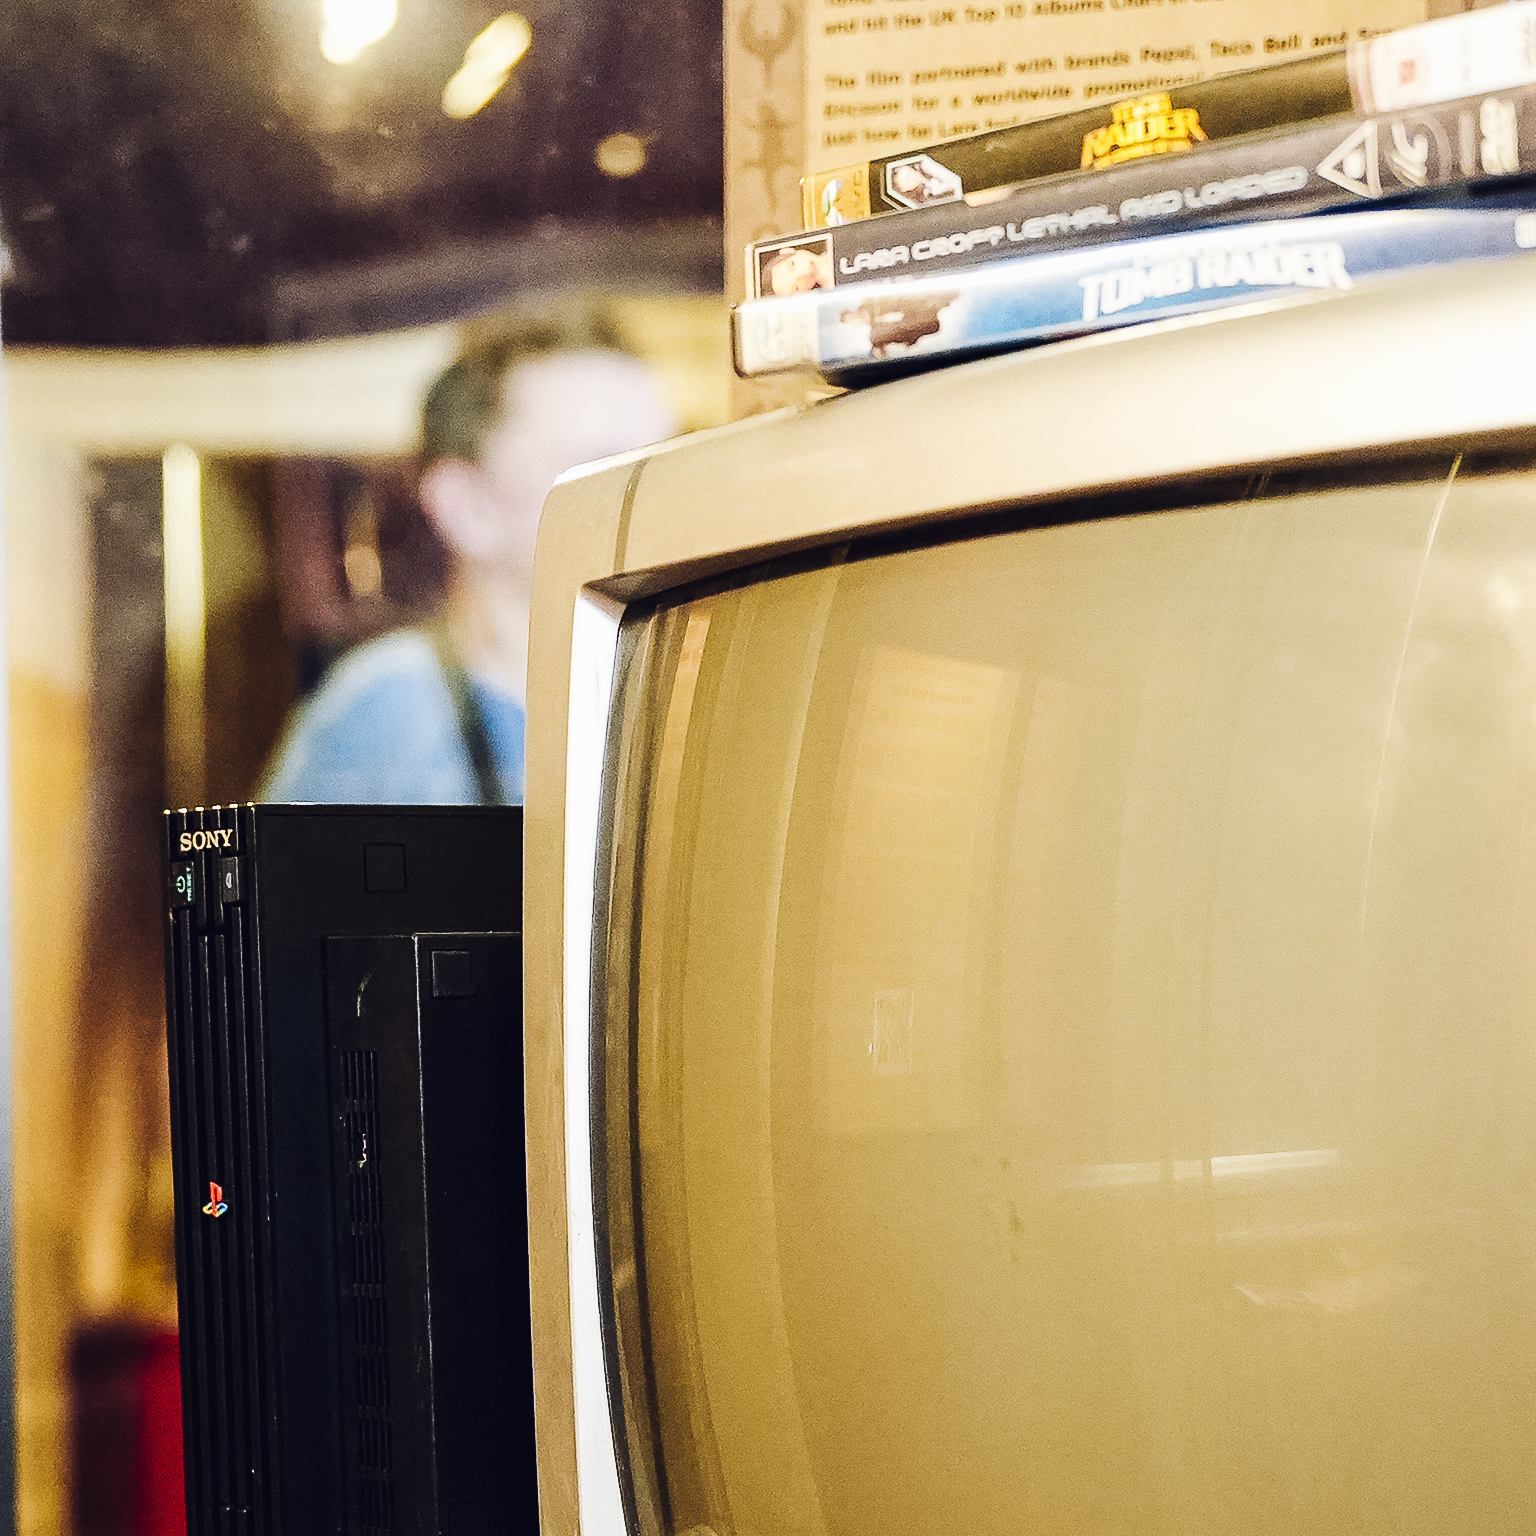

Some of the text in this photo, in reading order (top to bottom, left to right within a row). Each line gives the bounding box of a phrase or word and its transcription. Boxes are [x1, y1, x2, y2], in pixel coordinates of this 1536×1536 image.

[1014, 56, 1057, 73] with
[1263, 34, 1302, 54] Bell
[1310, 31, 1348, 48] and
[839, 245, 910, 275] LARA
[1078, 242, 1354, 322] TOMB RAIDER
[180, 829, 233, 851] SONY
